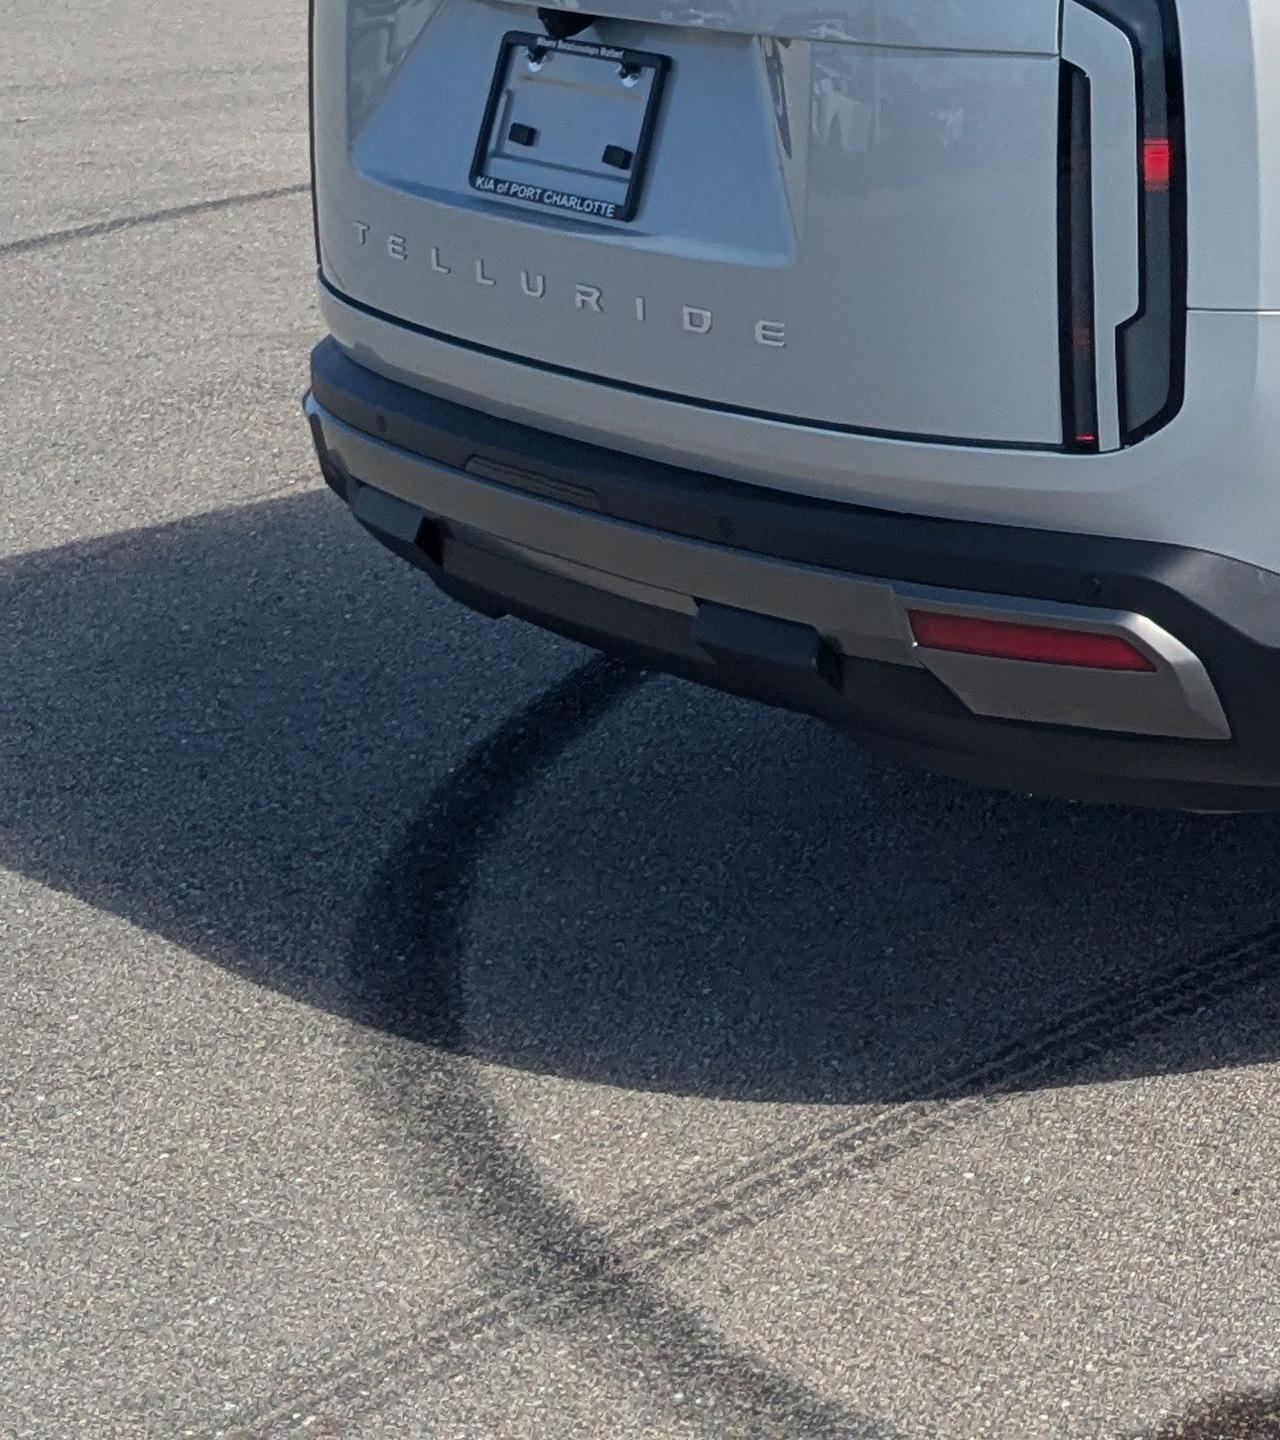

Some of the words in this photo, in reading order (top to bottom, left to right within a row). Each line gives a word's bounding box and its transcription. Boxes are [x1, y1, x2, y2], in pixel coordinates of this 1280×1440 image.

[475, 176, 495, 191] KIA
[497, 181, 509, 193] of
[510, 183, 543, 200] PORT
[543, 191, 616, 217] CHARLOTTE
[353, 221, 787, 347] TELLURIDE
